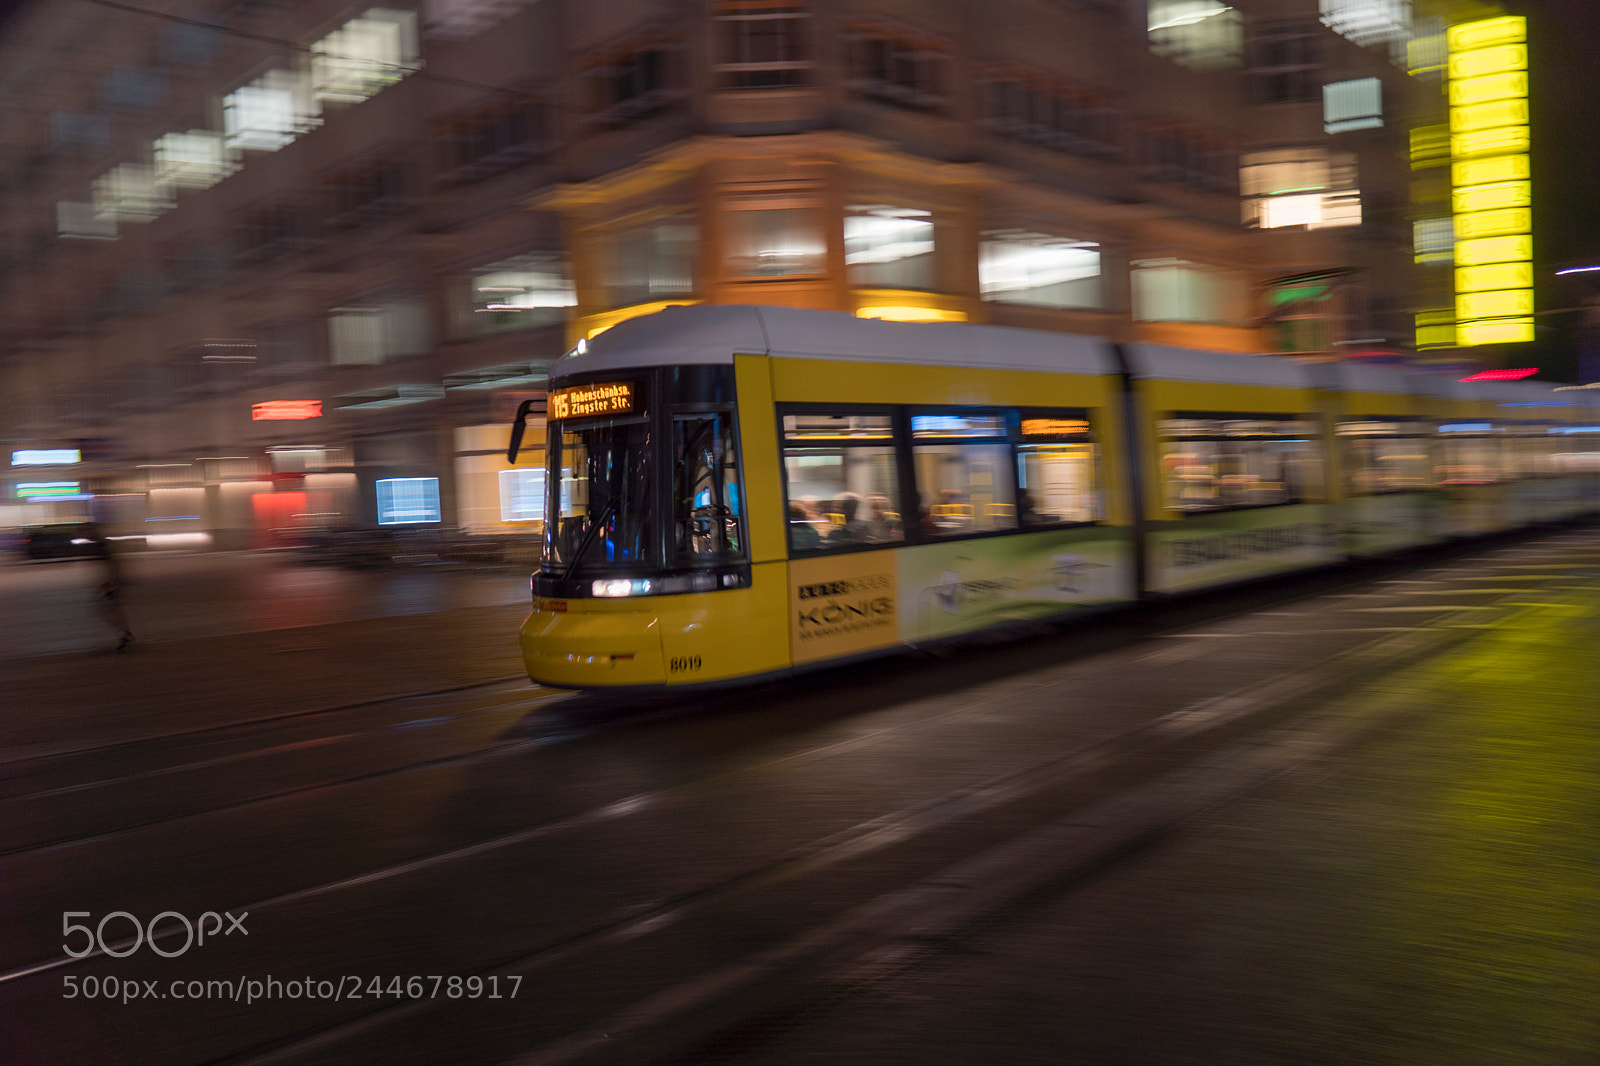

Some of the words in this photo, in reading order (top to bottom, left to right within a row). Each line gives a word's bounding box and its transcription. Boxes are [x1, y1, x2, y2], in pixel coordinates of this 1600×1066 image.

[553, 394, 569, 419] M5
[571, 400, 609, 415] Zingster
[611, 396, 631, 410] Str.
[670, 655, 702, 674] 8019
